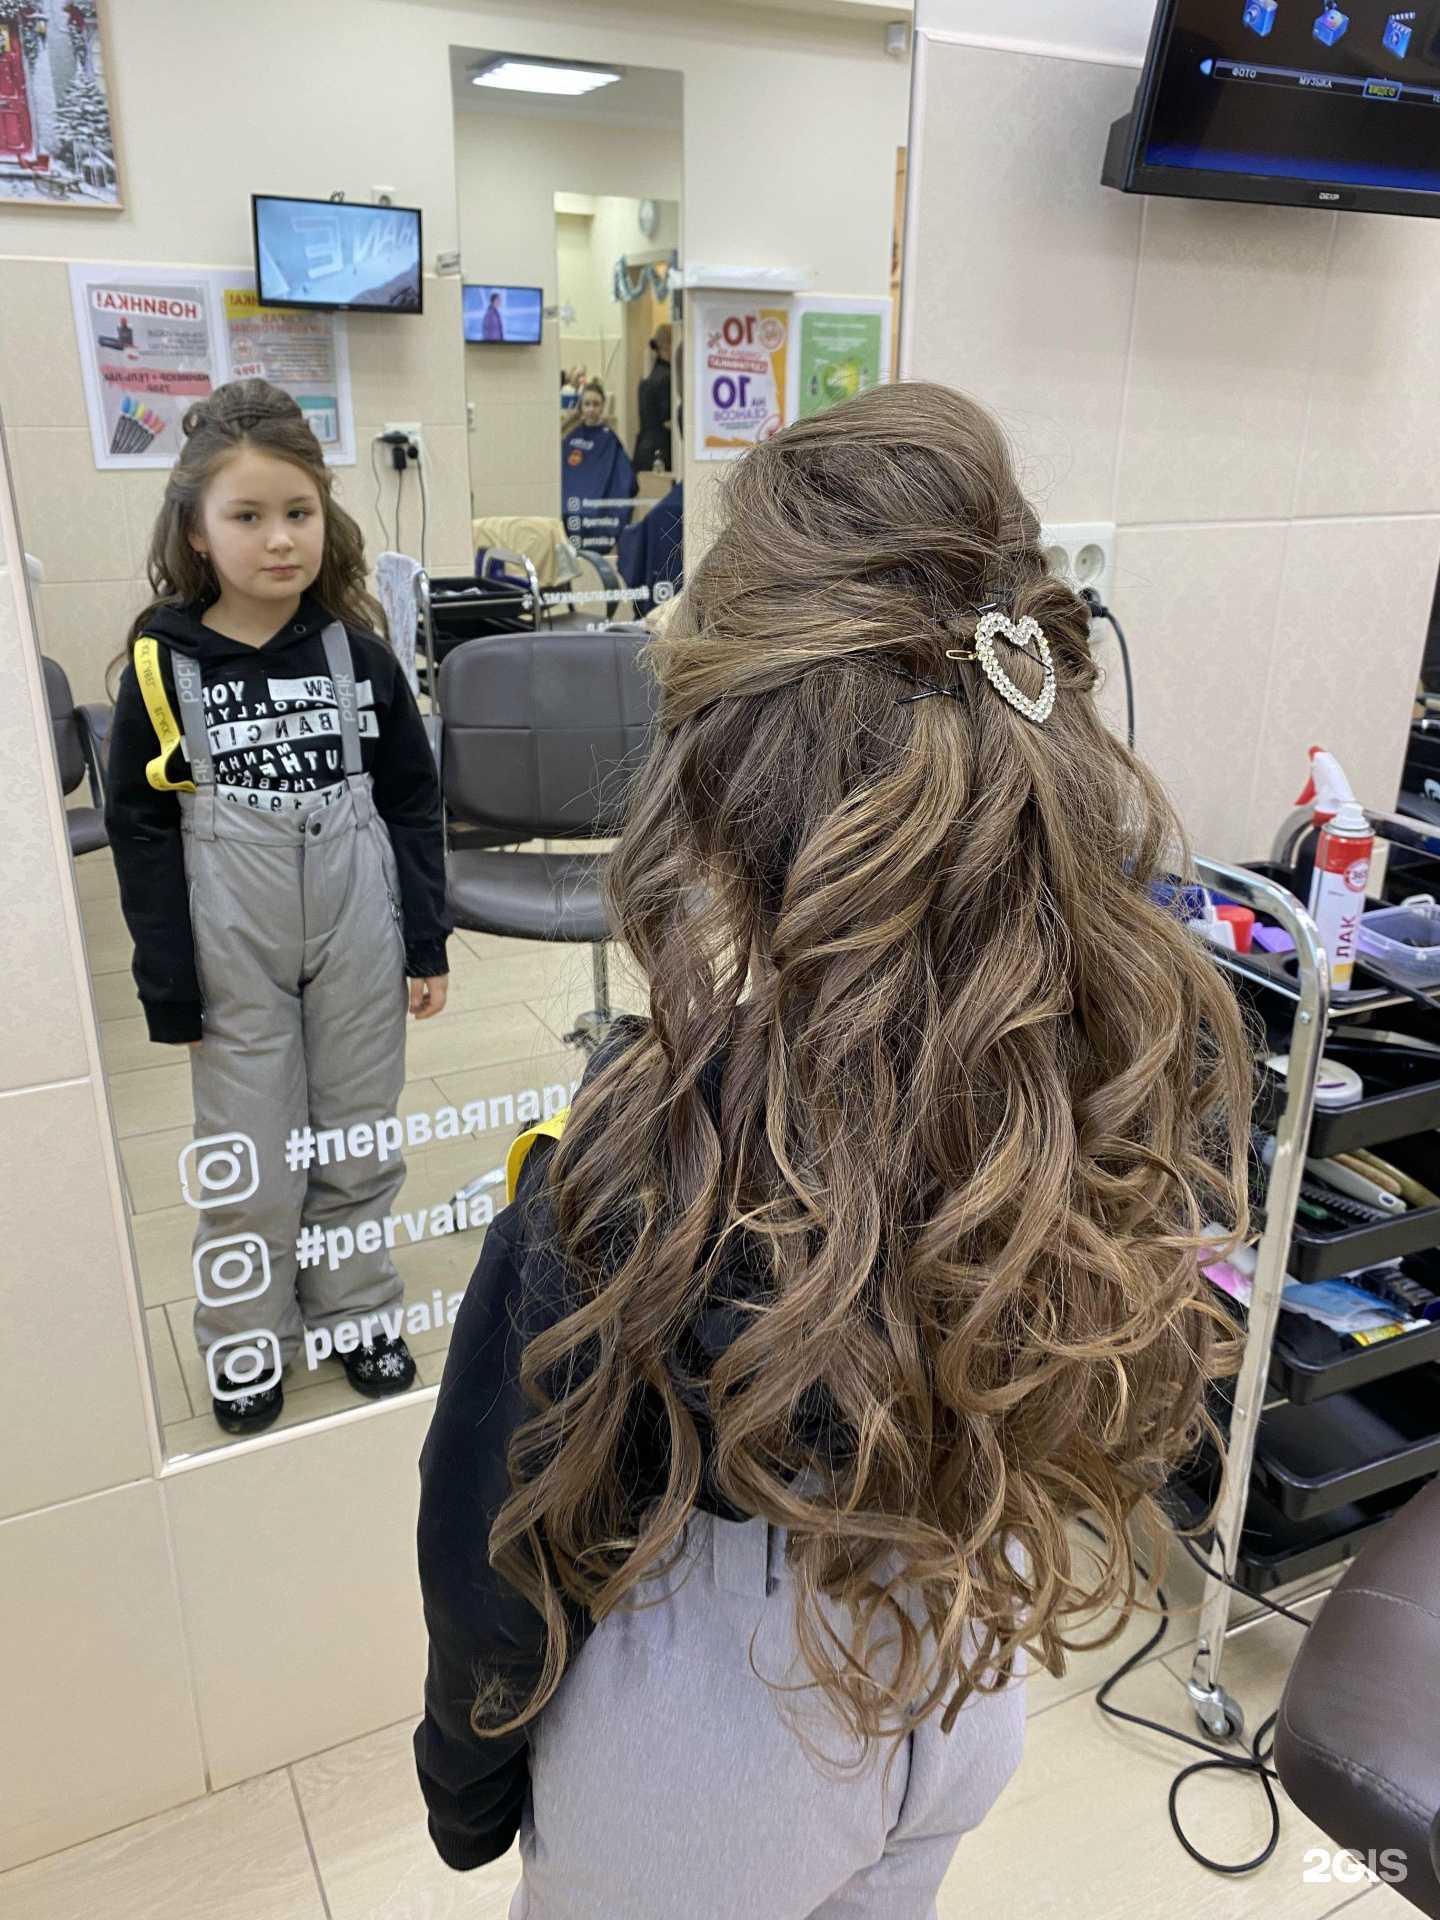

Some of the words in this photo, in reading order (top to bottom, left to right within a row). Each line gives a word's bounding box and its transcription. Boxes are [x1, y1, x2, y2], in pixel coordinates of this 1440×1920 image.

[1232, 67, 1257, 79] ФОТО
[1336, 915, 1356, 958] ЛАК
[285, 1080, 577, 1171] #перваяпар
